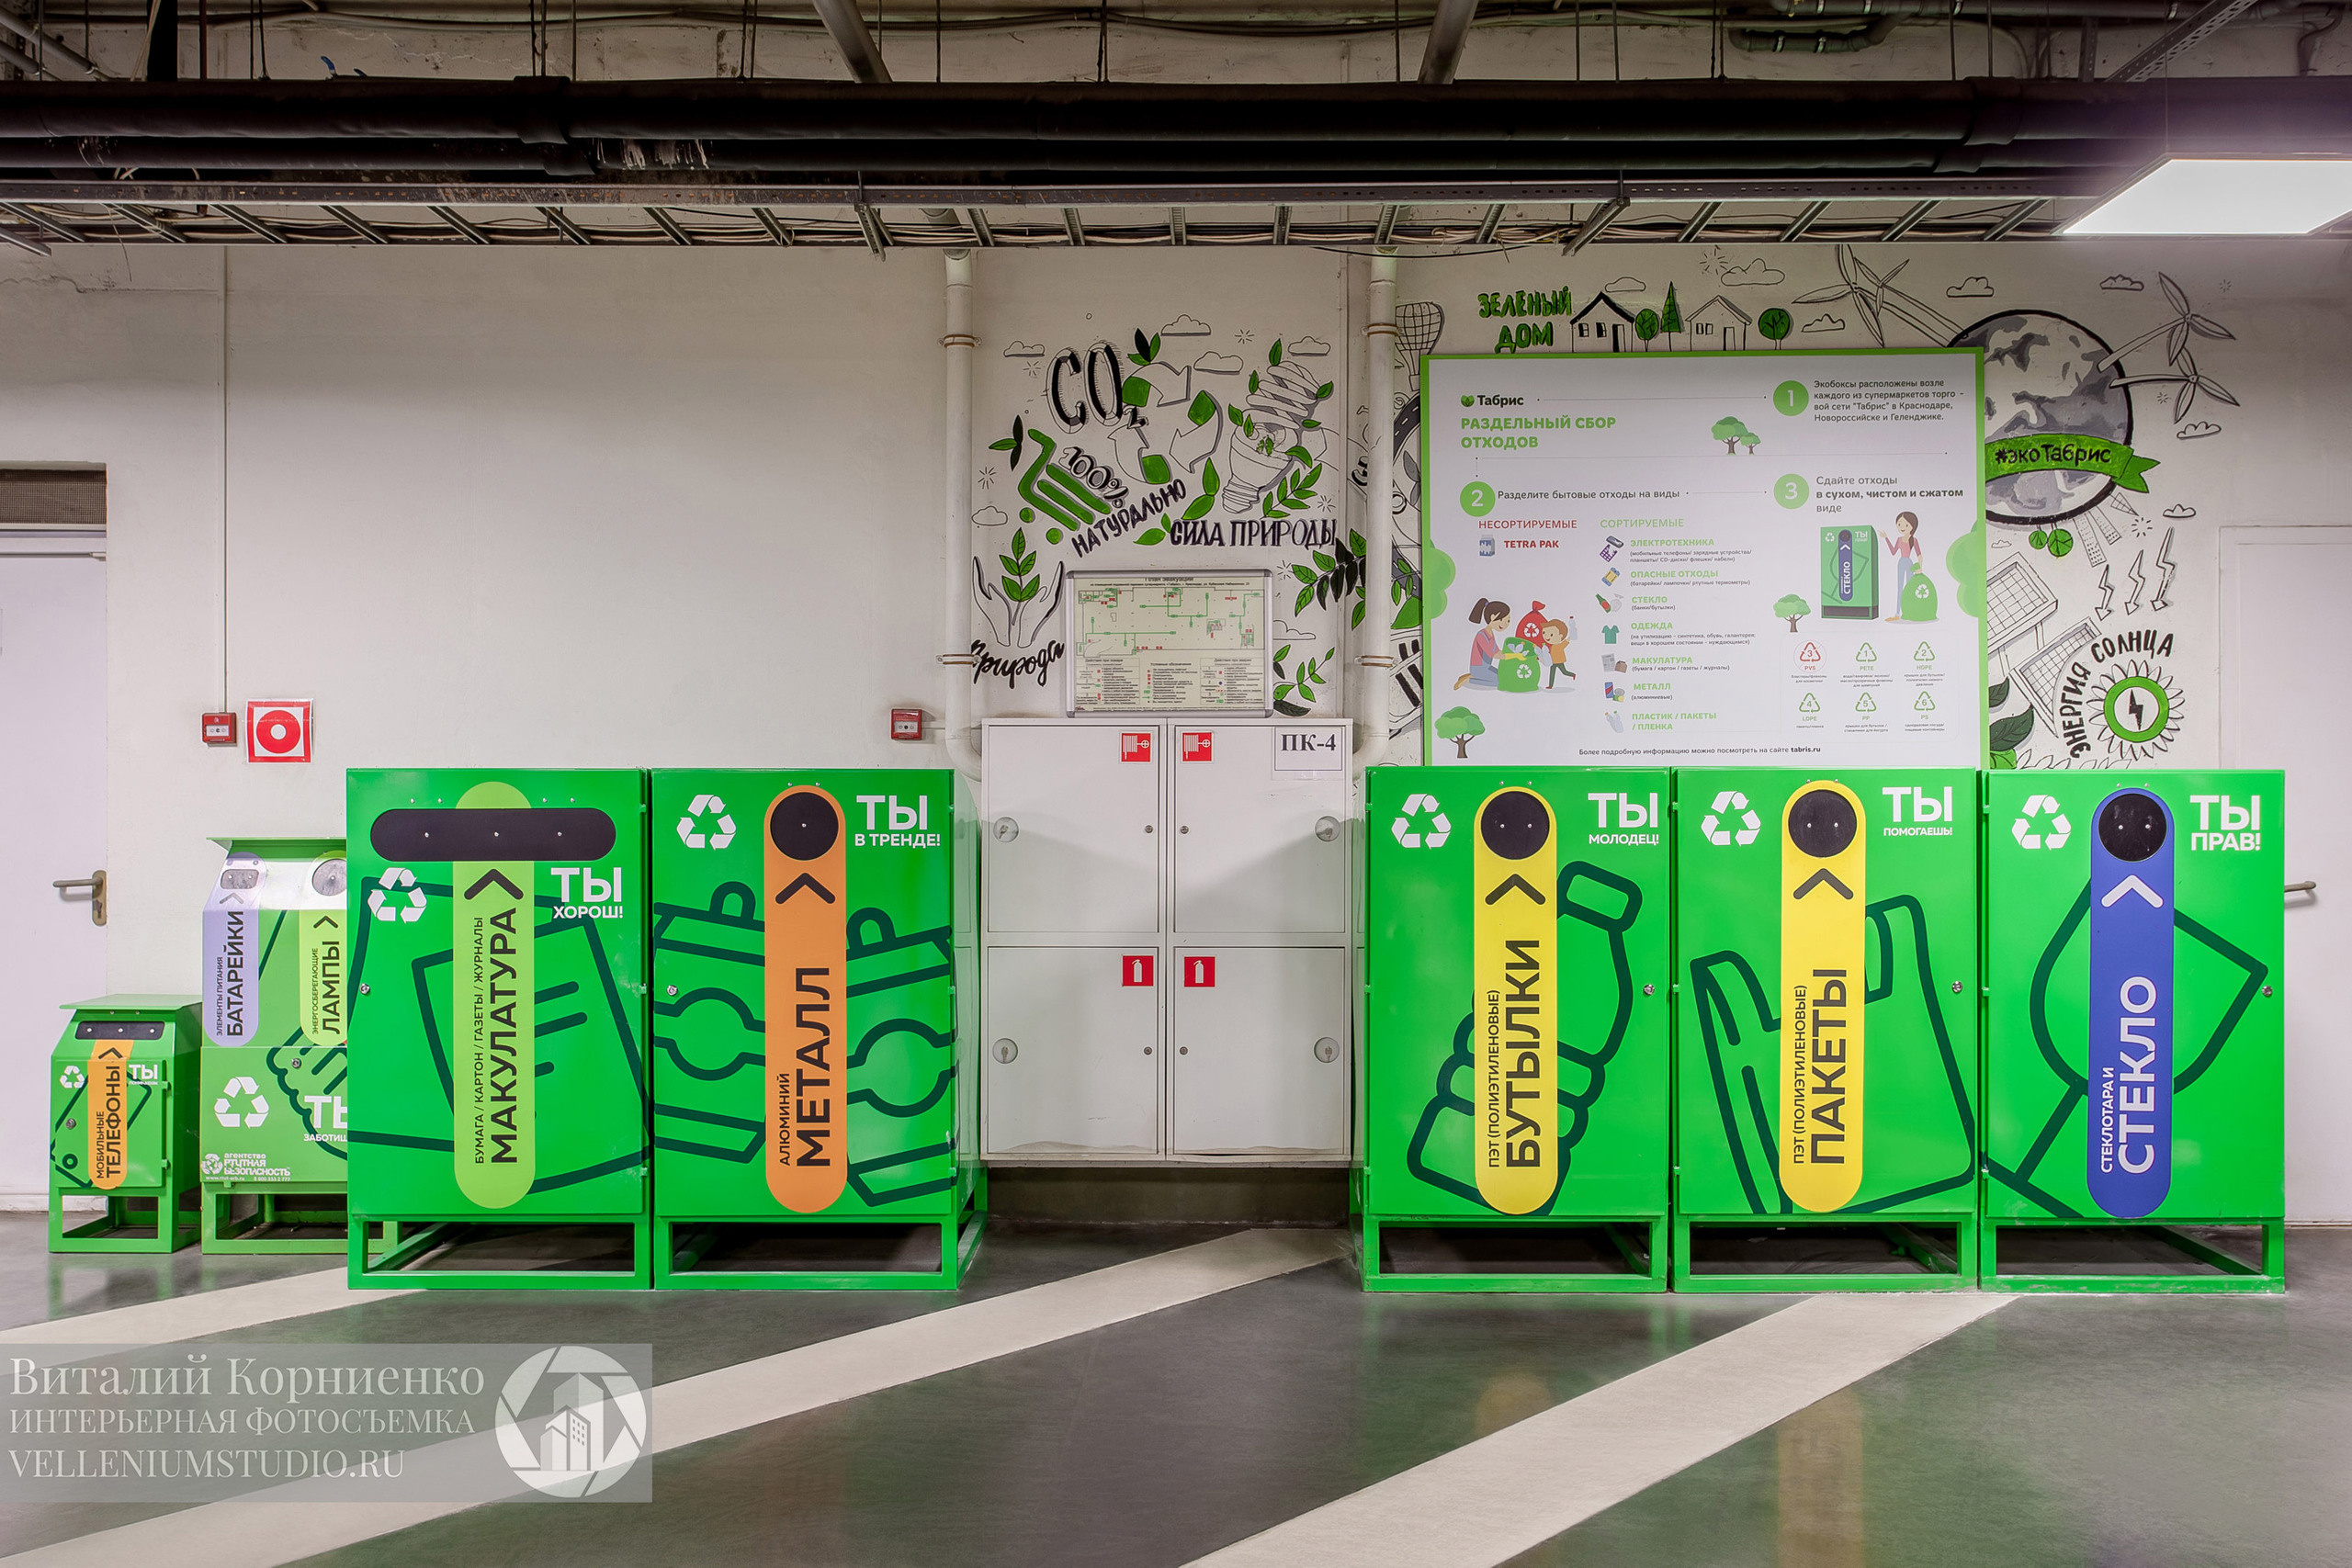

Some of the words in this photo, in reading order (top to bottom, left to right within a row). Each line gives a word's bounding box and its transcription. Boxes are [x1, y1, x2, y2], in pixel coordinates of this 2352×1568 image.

[1494, 321, 1554, 354] ДОМ
[1814, 380, 1857, 389] Экобоксы
[1859, 380, 1917, 389] расположены
[1920, 379, 1944, 388] возле
[1477, 394, 1524, 408] Табрис
[1787, 389, 1794, 407] 1
[1814, 392, 1850, 400] каждого
[1864, 391, 1929, 400] супермаркетов
[1814, 402, 1829, 411] вой
[1853, 401, 1889, 411] "Табрис"
[1899, 401, 1953, 411] Краснодаре,
[1461, 415, 1571, 431] РАЗДЕЛЬНЫЙ
[1575, 417, 1616, 429] СБОР
[1814, 413, 1881, 423] Новороссийске
[1891, 412, 1944, 422] Геленджике.
[1461, 436, 1539, 450] ОТХОДОВ
[1995, 443, 2111, 465] #экоТабрис
[1059, 446, 1129, 509] 100%
[1816, 476, 1855, 486] Сдайте
[1858, 477, 1897, 487] отходы
[1471, 490, 1484, 507] 2
[1498, 491, 1549, 500] Разделите
[1552, 490, 1596, 499] бытовые
[1600, 491, 1636, 500] отходы
[1654, 490, 1679, 499] виды
[1785, 482, 1798, 500] 3
[1826, 490, 1863, 500] сухом,
[1866, 490, 1907, 498] чистом
[1910, 489, 1917, 497] и
[1919, 489, 1963, 497] сжатом
[1071, 479, 1186, 558] НАТУРАЛЬНО
[1816, 504, 1842, 513] виде
[1170, 520, 1223, 547] СИЛА
[1230, 518, 1336, 550] ПРИРОДЫ
[1478, 520, 1577, 529] НЕСОРТИРУЕМЫЕ
[1600, 518, 1684, 528] СОРТИРУЕМЫЕ
[1504, 540, 1535, 548] TETRA
[1539, 539, 1559, 548] PAK
[1843, 561, 1851, 594] СТЕКЛО
[1630, 622, 1673, 630] ОДЕЖДА
[1634, 682, 1671, 691] МЕТАЛЛ
[2060, 661, 2091, 758] ЭНЕРГИЯ
[2090, 630, 2174, 662] СОЛНЦА
[1281, 734, 1336, 751] ПК-4
[1601, 749, 1642, 757] подробную
[1643, 748, 1690, 756] информацию
[856, 795, 927, 830] ТЫ
[1588, 793, 1658, 829] ТЫ
[1882, 786, 1952, 822] ТЫ
[2189, 795, 2260, 831] ТЫ
[854, 833, 866, 847] В
[869, 833, 941, 849] ТРЕНДЕ!
[1589, 833, 1659, 846] МОЛОДЕЦ!
[1883, 827, 1953, 836] ПОМОГАЕШЬ!
[2190, 832, 2261, 851] ПРАВ!
[551, 867, 622, 903] ТЫ
[553, 906, 623, 919] ХОРОШ!
[473, 917, 484, 983] ЖУРНАЛЫ
[223, 910, 243, 1036] БАТАРЕЙКИ
[311, 947, 320, 1035] ЭНЕРГОСБЕРЕГАЮЩИЕ
[322, 941, 341, 1035] ЛАМПЫ
[474, 994, 484, 1042] ГАЗЕТЫ
[490, 907, 518, 1164] МАКУЛАТУРА
[1487, 989, 1500, 1138] (ПОЛИЭТИЛЕНОВЫЕ)
[1505, 939, 1541, 1168] БУТЫЛКИ
[1792, 985, 1807, 1134] (ПОЛИЭТИЛЕНОВЫЕ)
[129, 1064, 158, 1080] ТЫ
[474, 1052, 484, 1103] КАРТОН
[796, 967, 831, 1168] МЕТАЛЛ
[1811, 968, 1848, 1165] ПАКЕТЫ
[2102, 1066, 2114, 1083] И
[2118, 976, 2157, 1174] СТЕКЛО
[106, 1066, 121, 1178] ТЕЛЕФОНЫ
[777, 1073, 791, 1166] АЛЮМИНИЙ
[2100, 1087, 2114, 1174] СТЕКЛОТАРА
[96, 1111, 105, 1179] МОБИЛЬНЫЕ
[304, 1134, 347, 1142] ЗАБОТИШ
[474, 1114, 484, 1164] БУМАГА
[1488, 1140, 1499, 1168] ПЭТ
[1793, 1136, 1804, 1165] ПЭТ
[224, 1159, 266, 1168] РТУТНАЯ
[224, 1168, 290, 1176] БЕЗОПАСНОСТЬ
